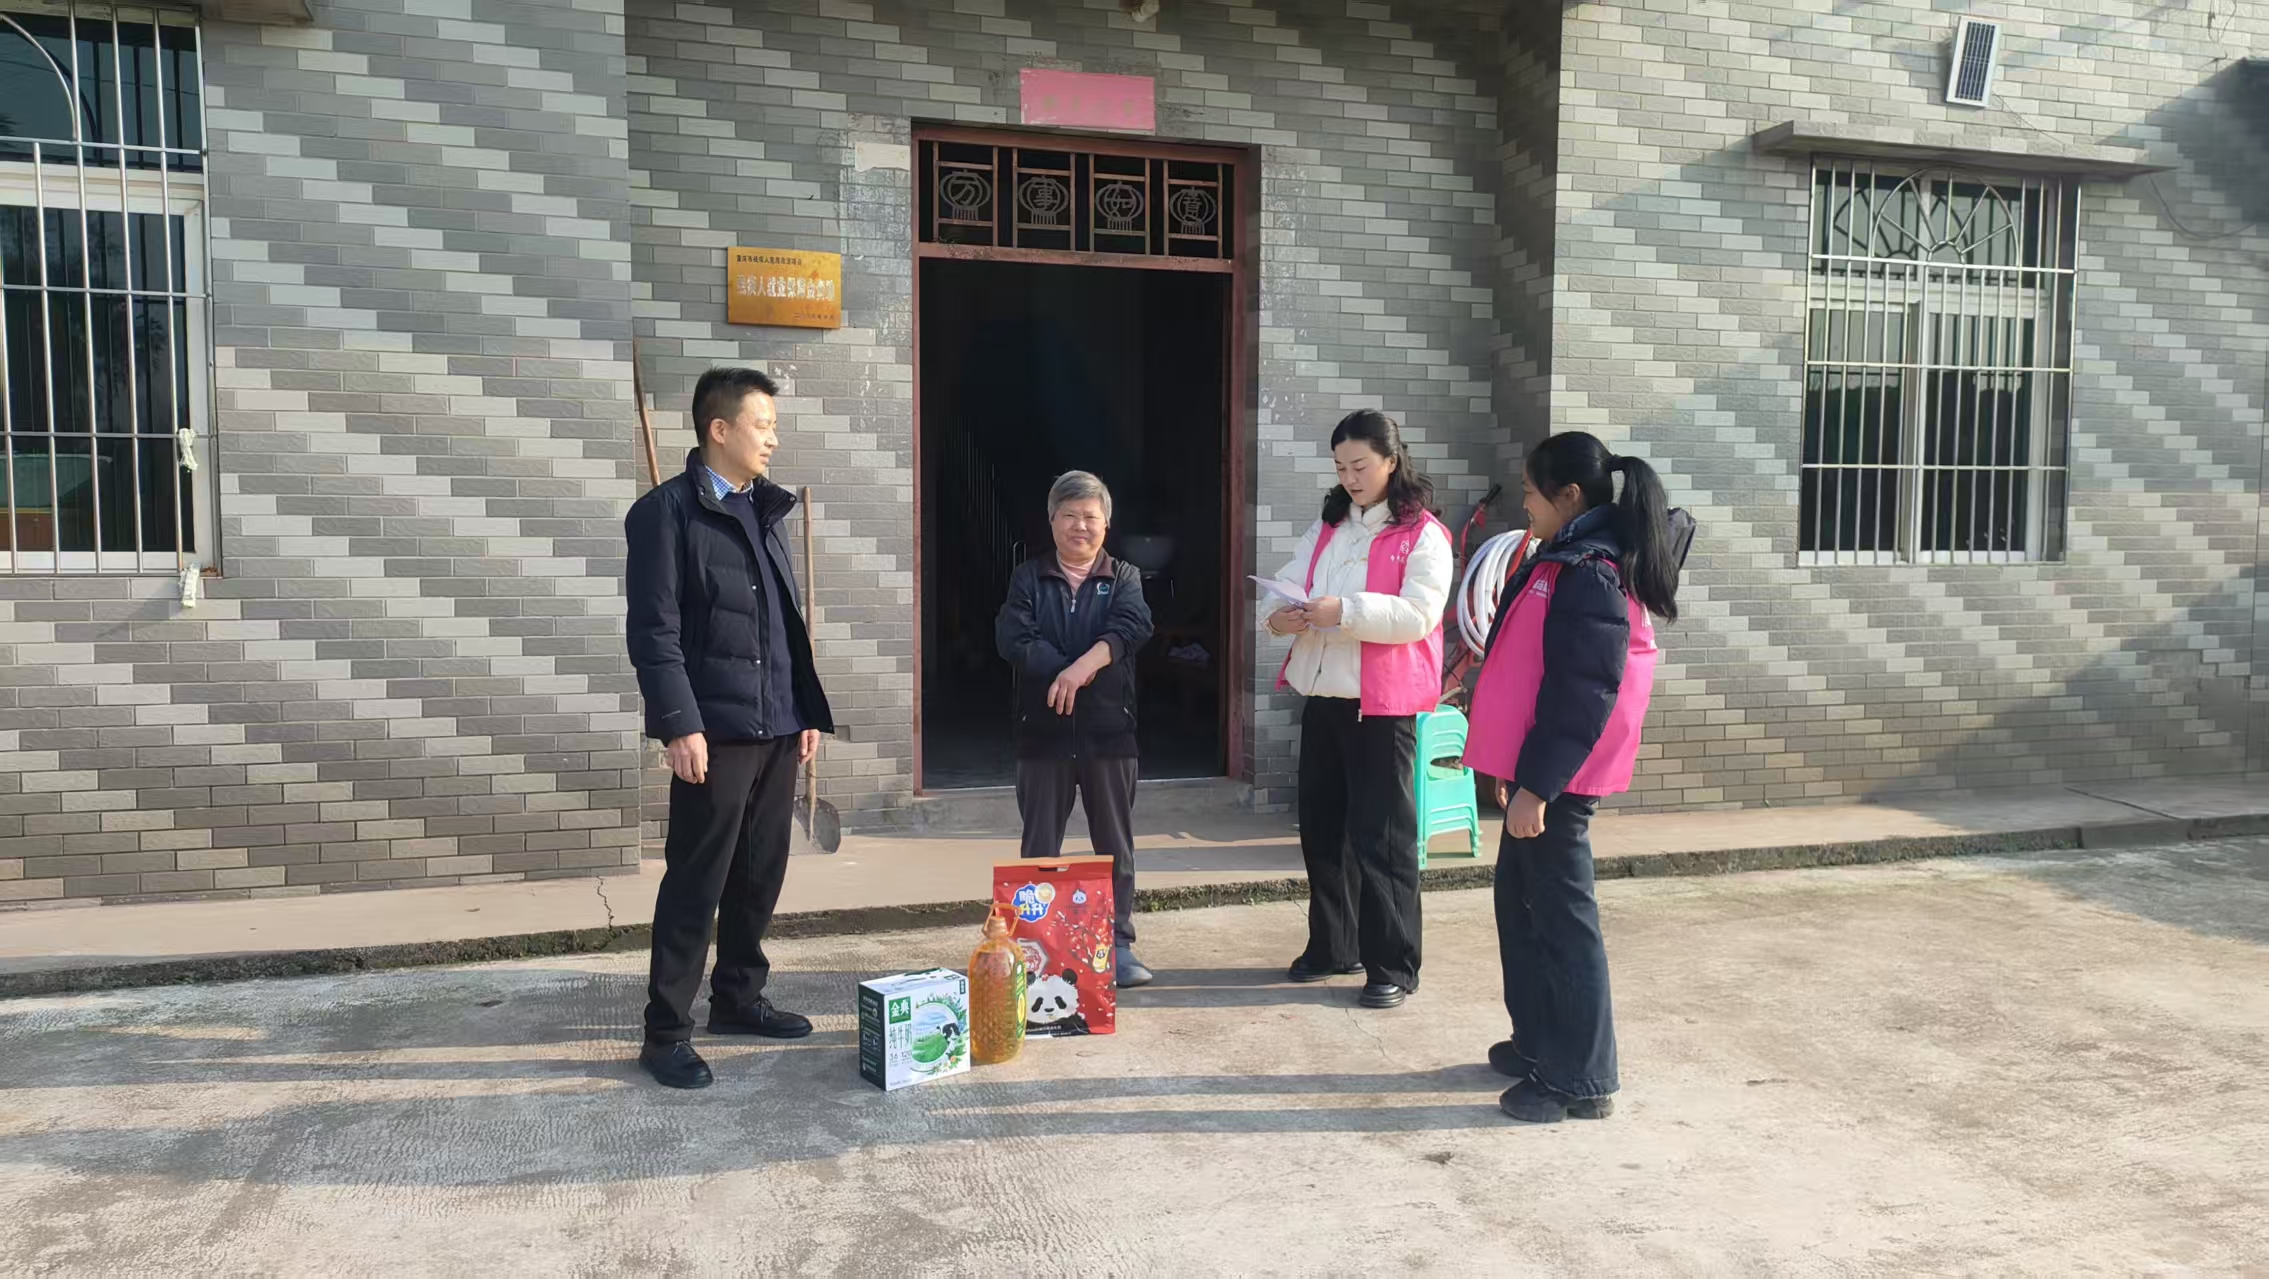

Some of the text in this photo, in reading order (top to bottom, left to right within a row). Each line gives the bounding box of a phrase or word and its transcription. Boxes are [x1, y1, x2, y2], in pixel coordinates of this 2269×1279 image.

[890, 999, 910, 1018] 金典
[889, 1024, 912, 1049] 纯牛奶
